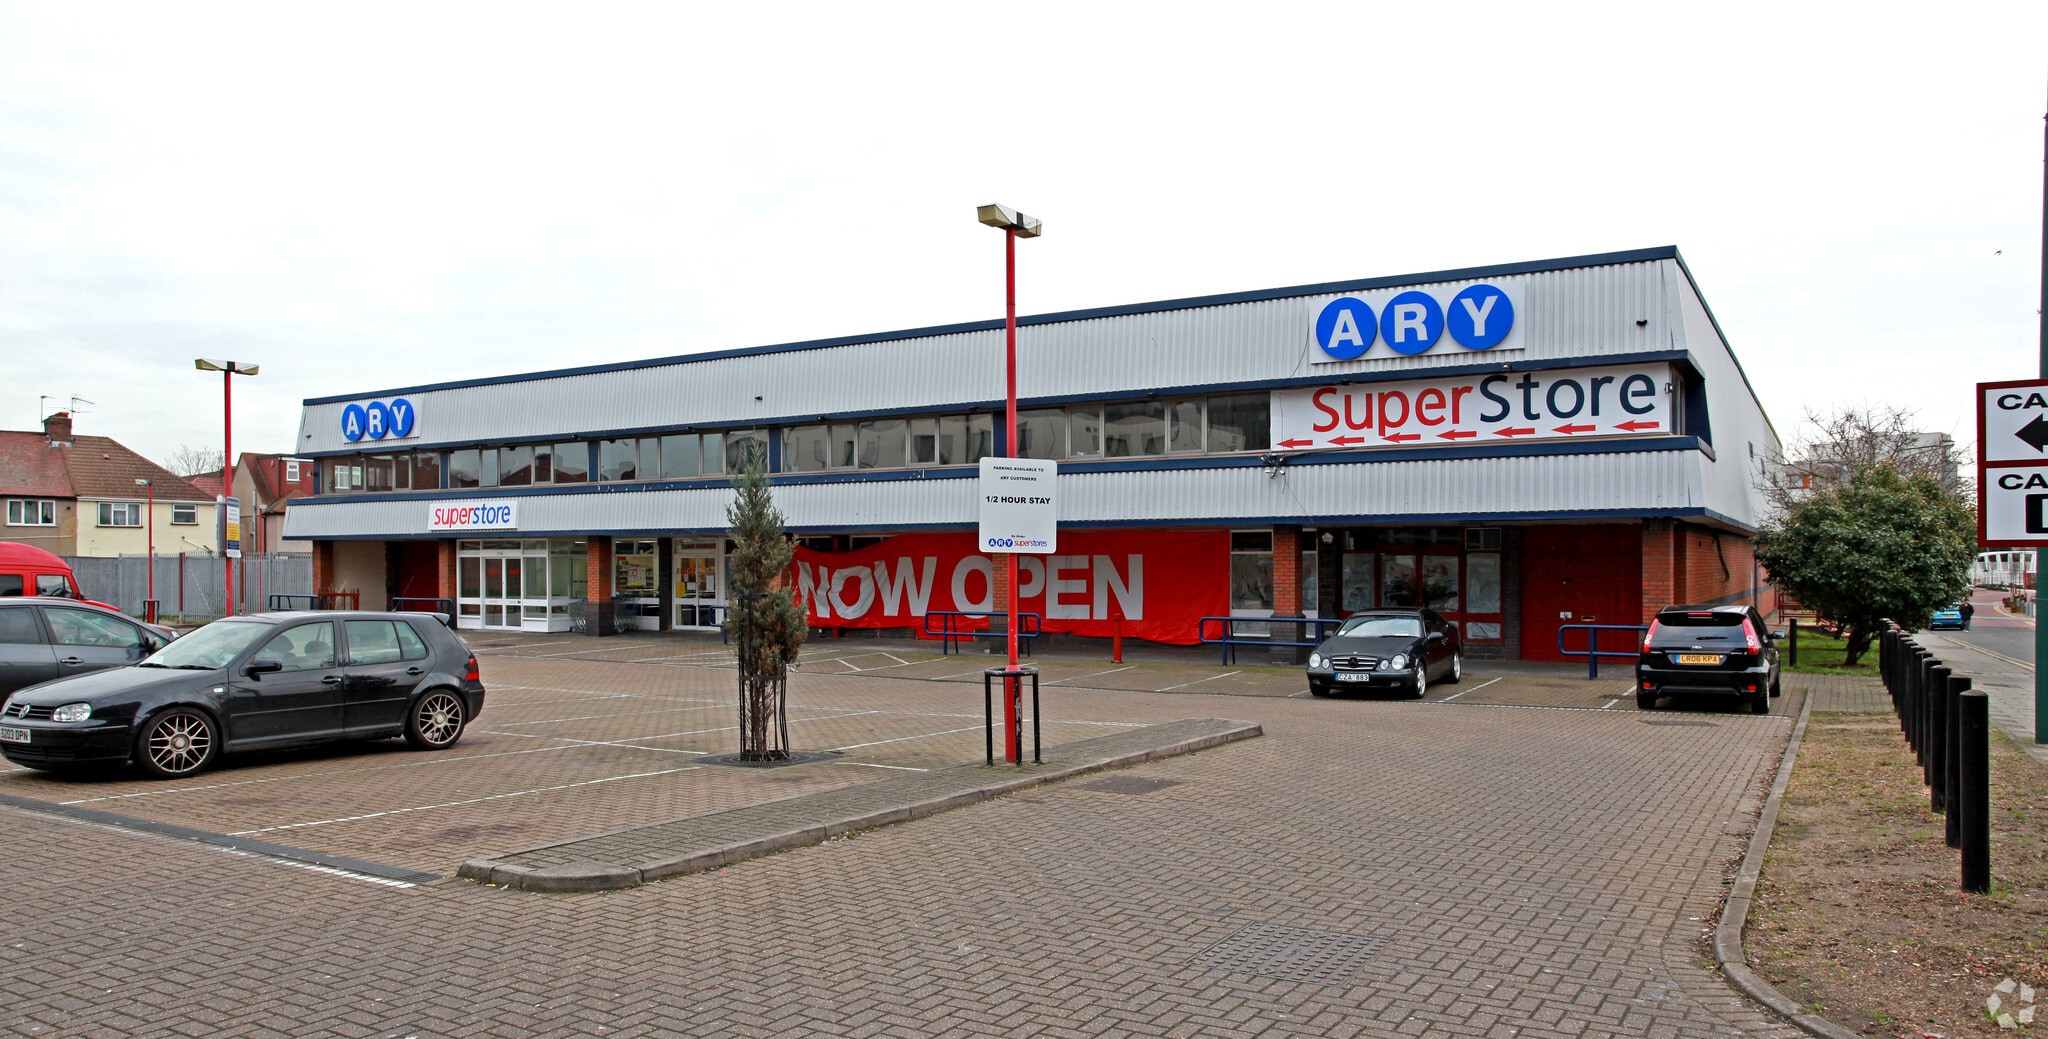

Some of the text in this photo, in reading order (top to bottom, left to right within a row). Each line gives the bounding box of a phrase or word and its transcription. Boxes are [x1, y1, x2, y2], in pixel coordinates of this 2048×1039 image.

[1327, 295, 1499, 349] ARY
[1312, 372, 1656, 437] SuperStore
[346, 405, 407, 436] ARY
[986, 495, 1051, 505] 1/2 HOUR STAY
[434, 503, 511, 528] superstore
[989, 538, 1013, 547] ARY
[797, 554, 1144, 620] NOW OPEN
[1703, 655, 1718, 663] KPA
[15, 729, 29, 741] DPN
